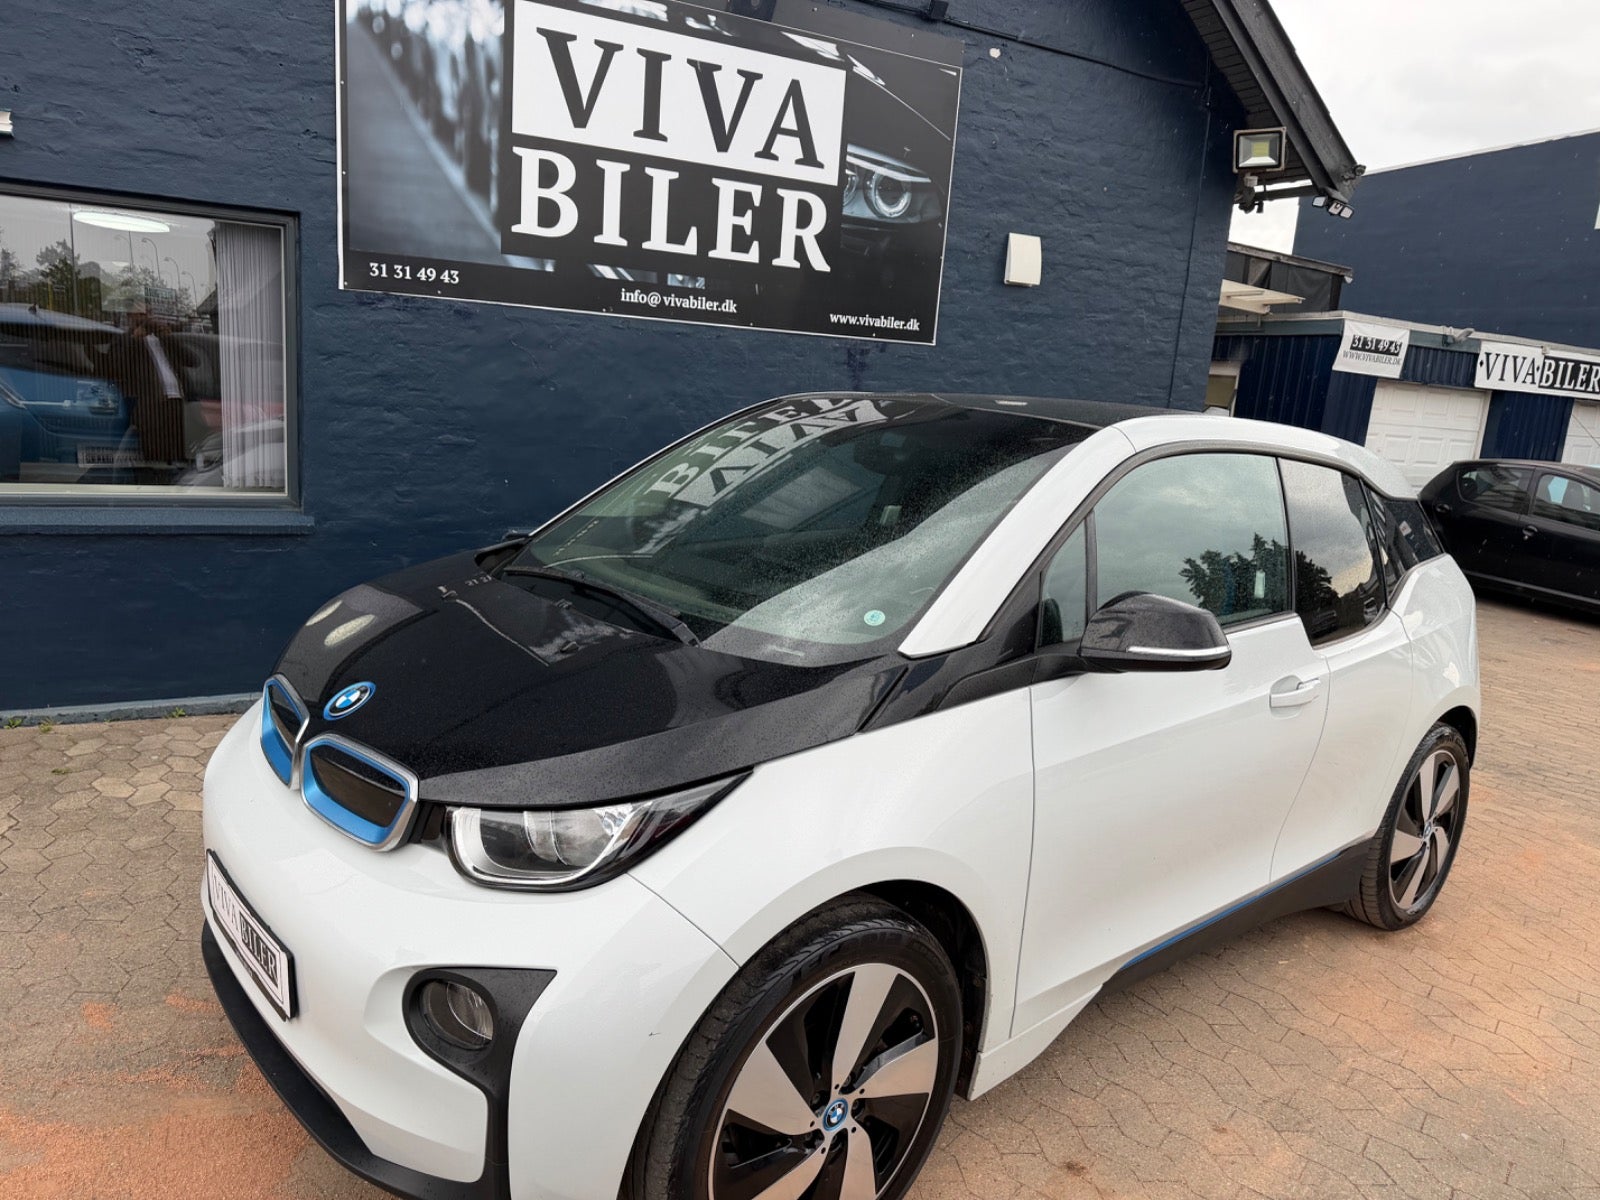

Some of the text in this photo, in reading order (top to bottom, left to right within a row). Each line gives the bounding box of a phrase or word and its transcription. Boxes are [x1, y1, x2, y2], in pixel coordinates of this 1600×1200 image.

[536, 26, 825, 170] VIVA
[510, 145, 832, 273] BILER
[369, 262, 460, 285] 31 31 49 43
[829, 313, 920, 331] www.vivabiler.dk
[1365, 337, 1376, 351] 31
[1377, 338, 1389, 352] 49
[1484, 351, 1600, 393] VIVA BILER
[212, 874, 241, 932] VIVA
[240, 918, 279, 981] BILER
